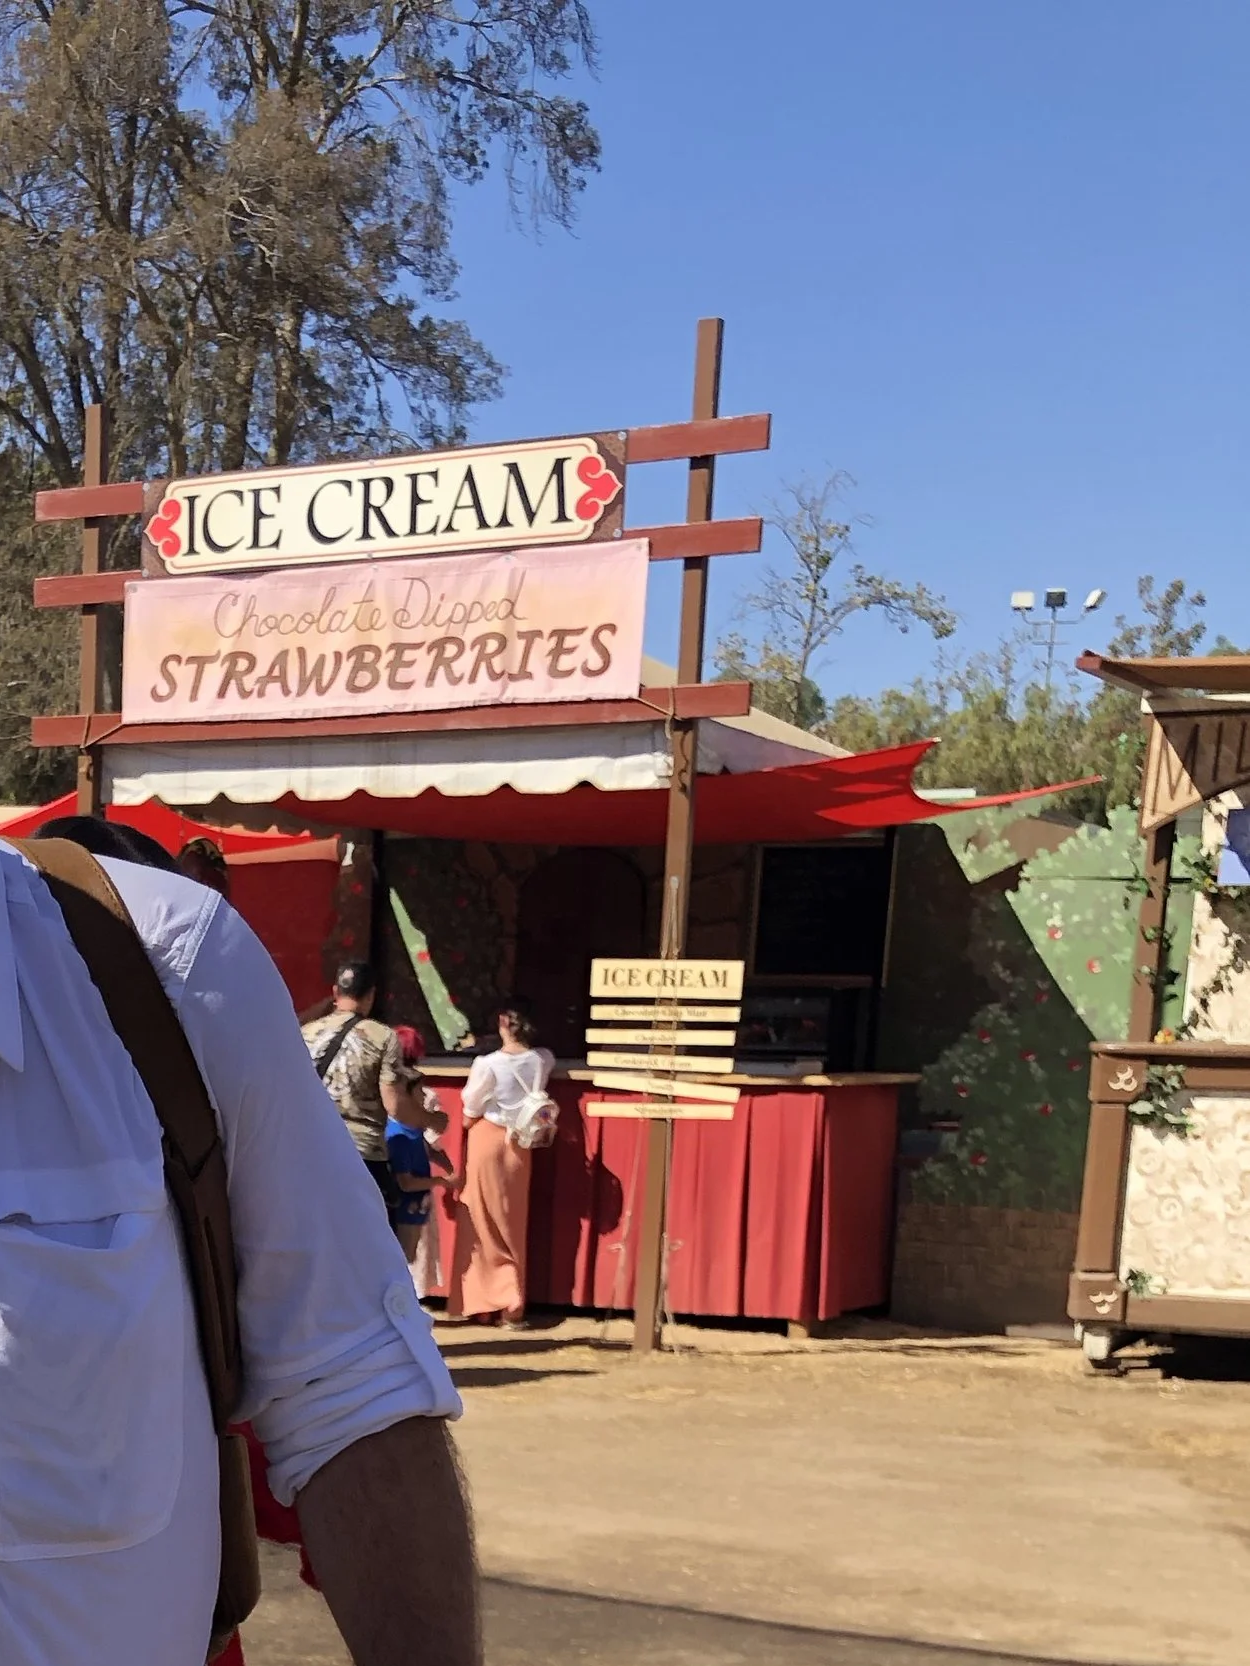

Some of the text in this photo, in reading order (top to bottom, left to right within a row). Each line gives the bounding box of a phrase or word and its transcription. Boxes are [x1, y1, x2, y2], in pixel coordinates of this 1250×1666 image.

[182, 456, 574, 557] ICE CREAM
[213, 566, 528, 639] Chocolate Dipped
[150, 622, 618, 703] STRAWBERRIES
[602, 967, 729, 989] ICE CREAM
